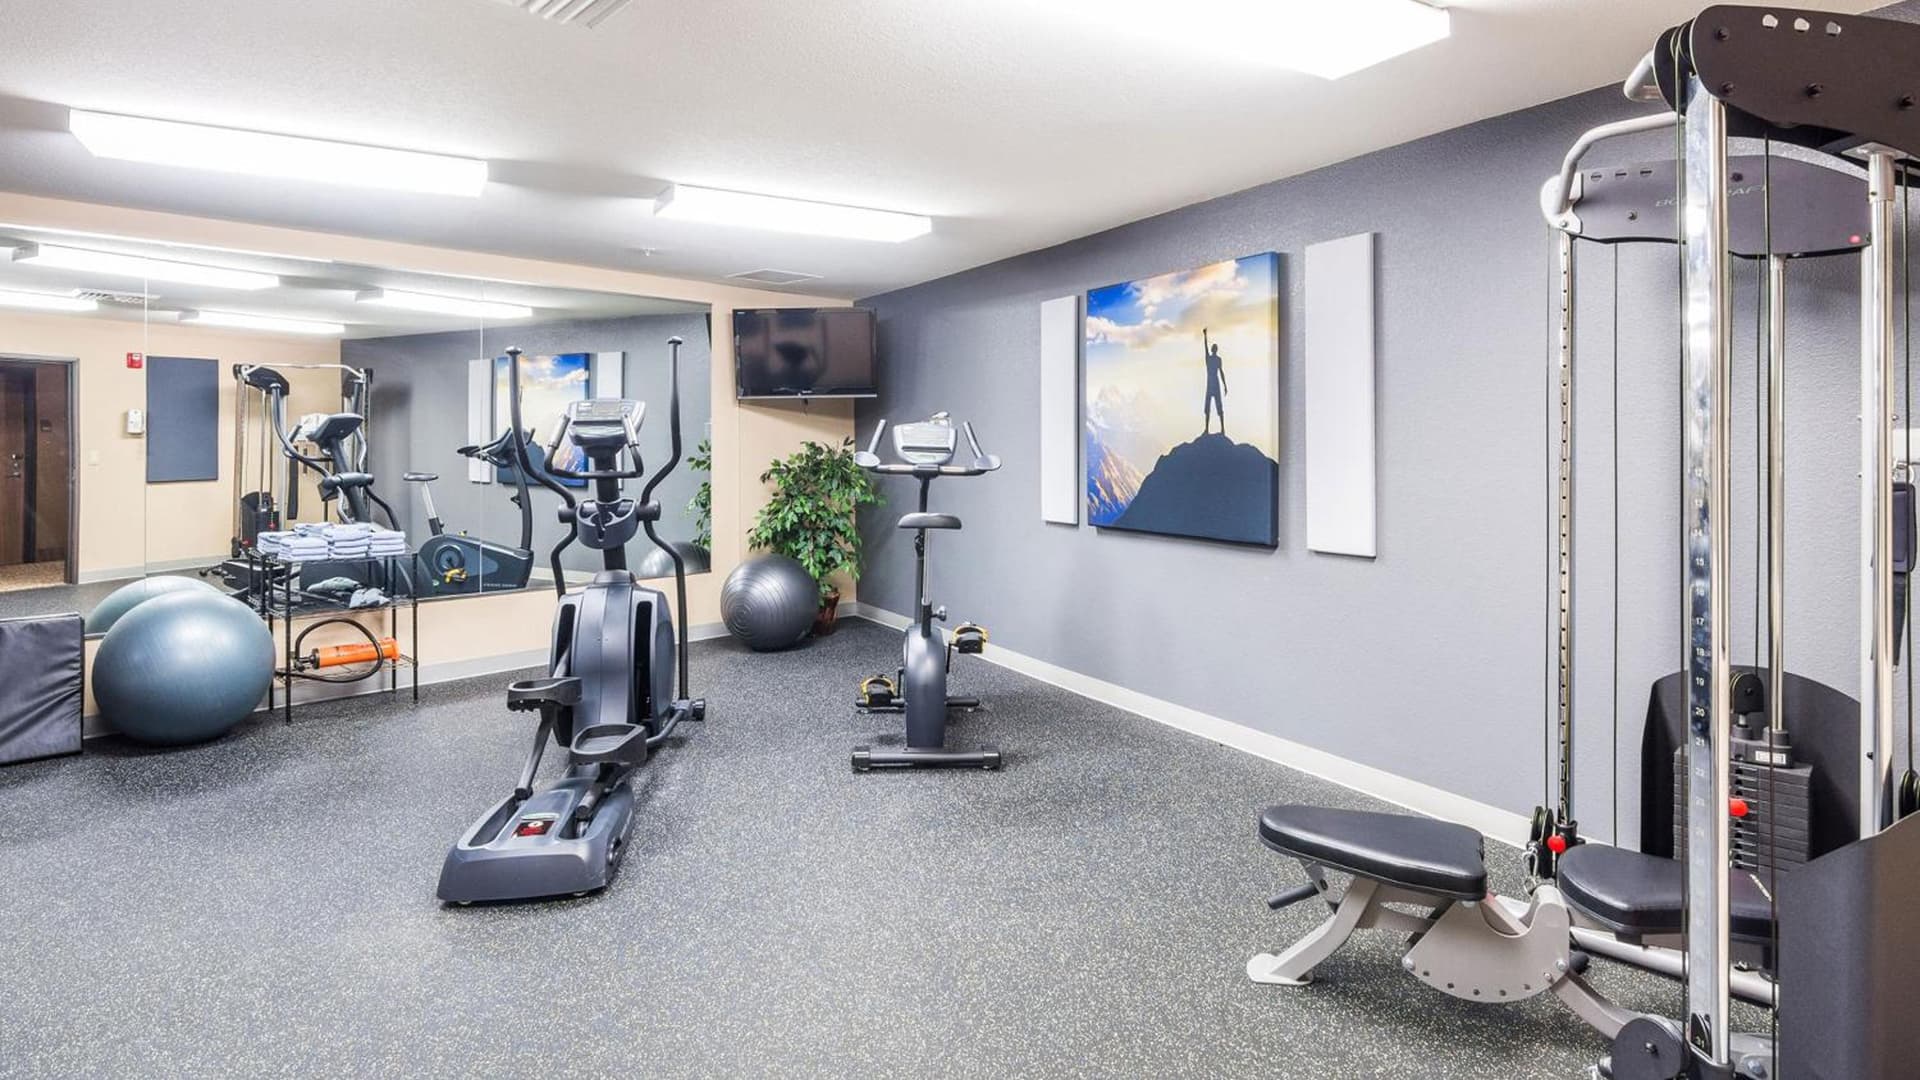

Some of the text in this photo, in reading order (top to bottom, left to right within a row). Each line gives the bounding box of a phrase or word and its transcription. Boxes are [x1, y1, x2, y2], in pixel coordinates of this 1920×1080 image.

[1695, 557, 1705, 567] 15
[1695, 617, 1705, 626] 17
[1695, 676, 1705, 687] 19
[1695, 706, 1705, 717] 20
[1695, 736, 1705, 747] 21
